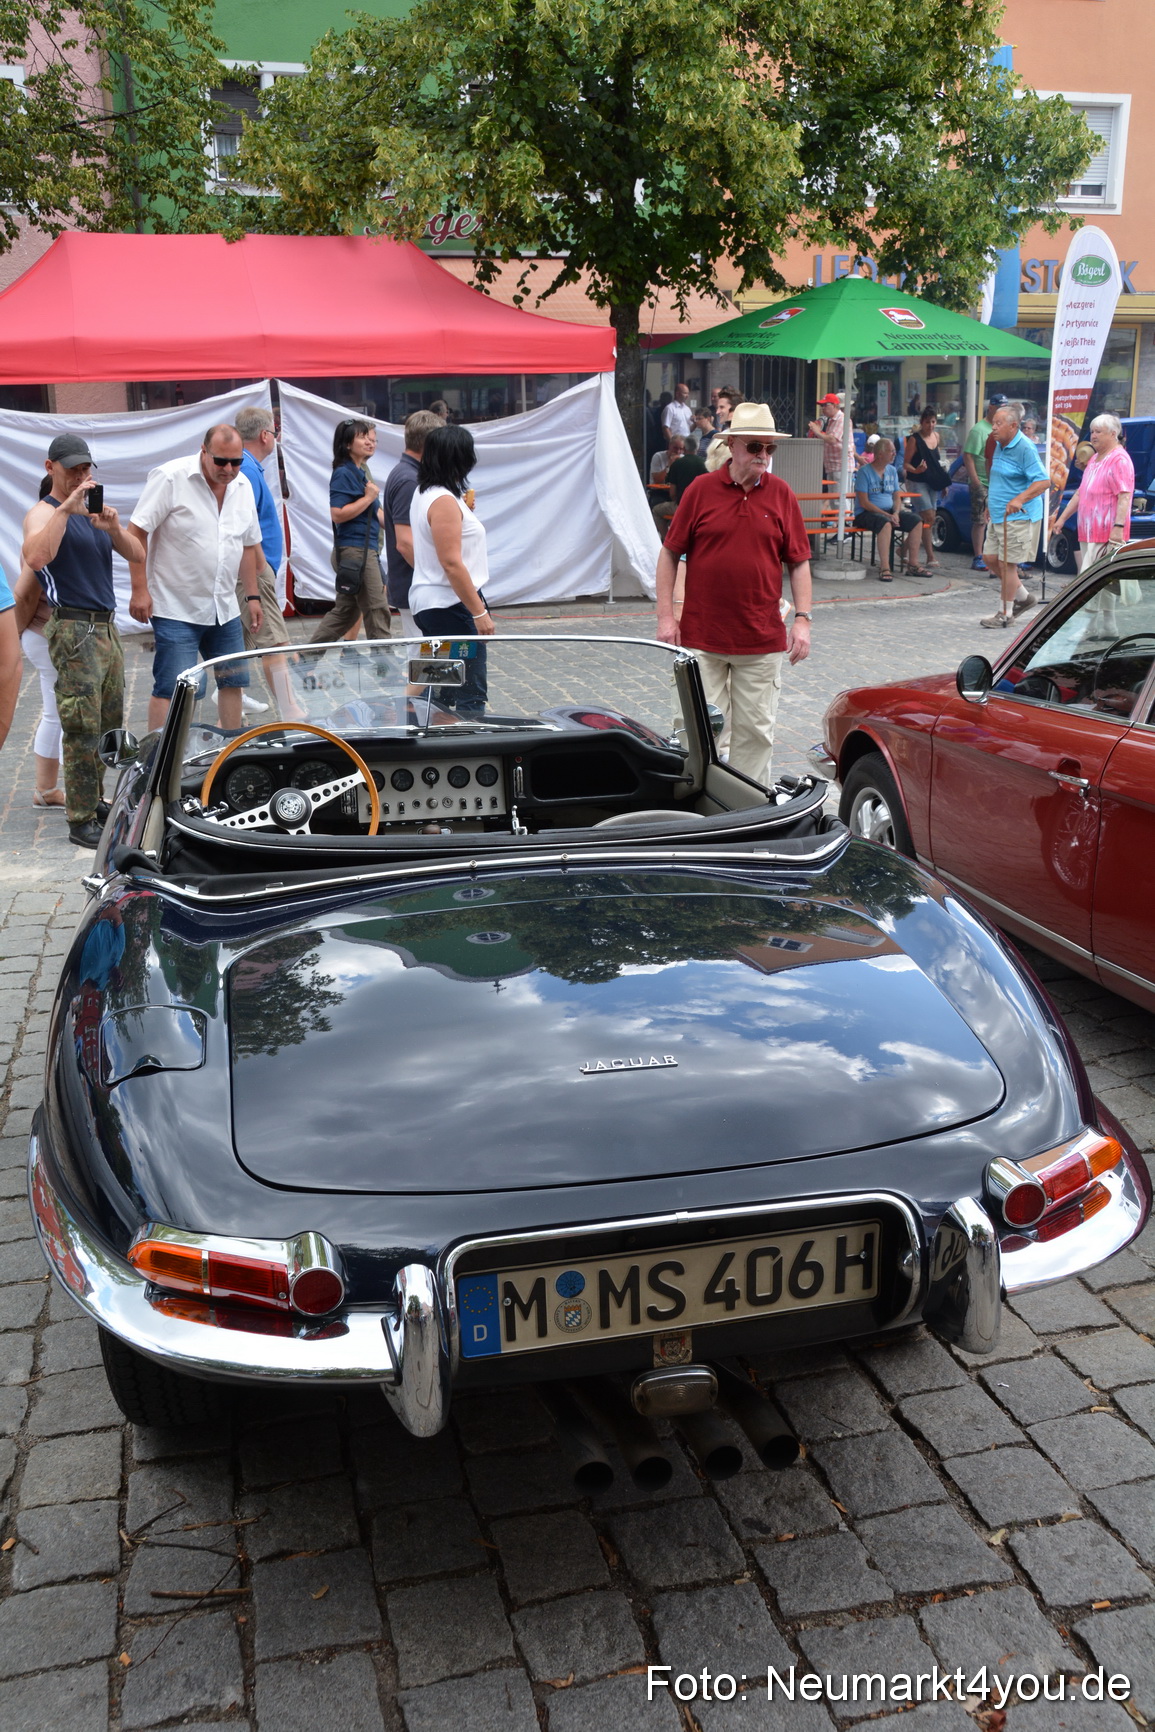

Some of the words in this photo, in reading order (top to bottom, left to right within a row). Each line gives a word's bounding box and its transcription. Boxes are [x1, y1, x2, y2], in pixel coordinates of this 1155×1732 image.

[876, 340, 990, 351] Lammsbräu
[883, 332, 964, 341] Neumarkter
[579, 1055, 679, 1073] JAGUAR
[503, 1276, 548, 1342] M
[598, 1259, 687, 1330] MS
[473, 1324, 488, 1342] D
